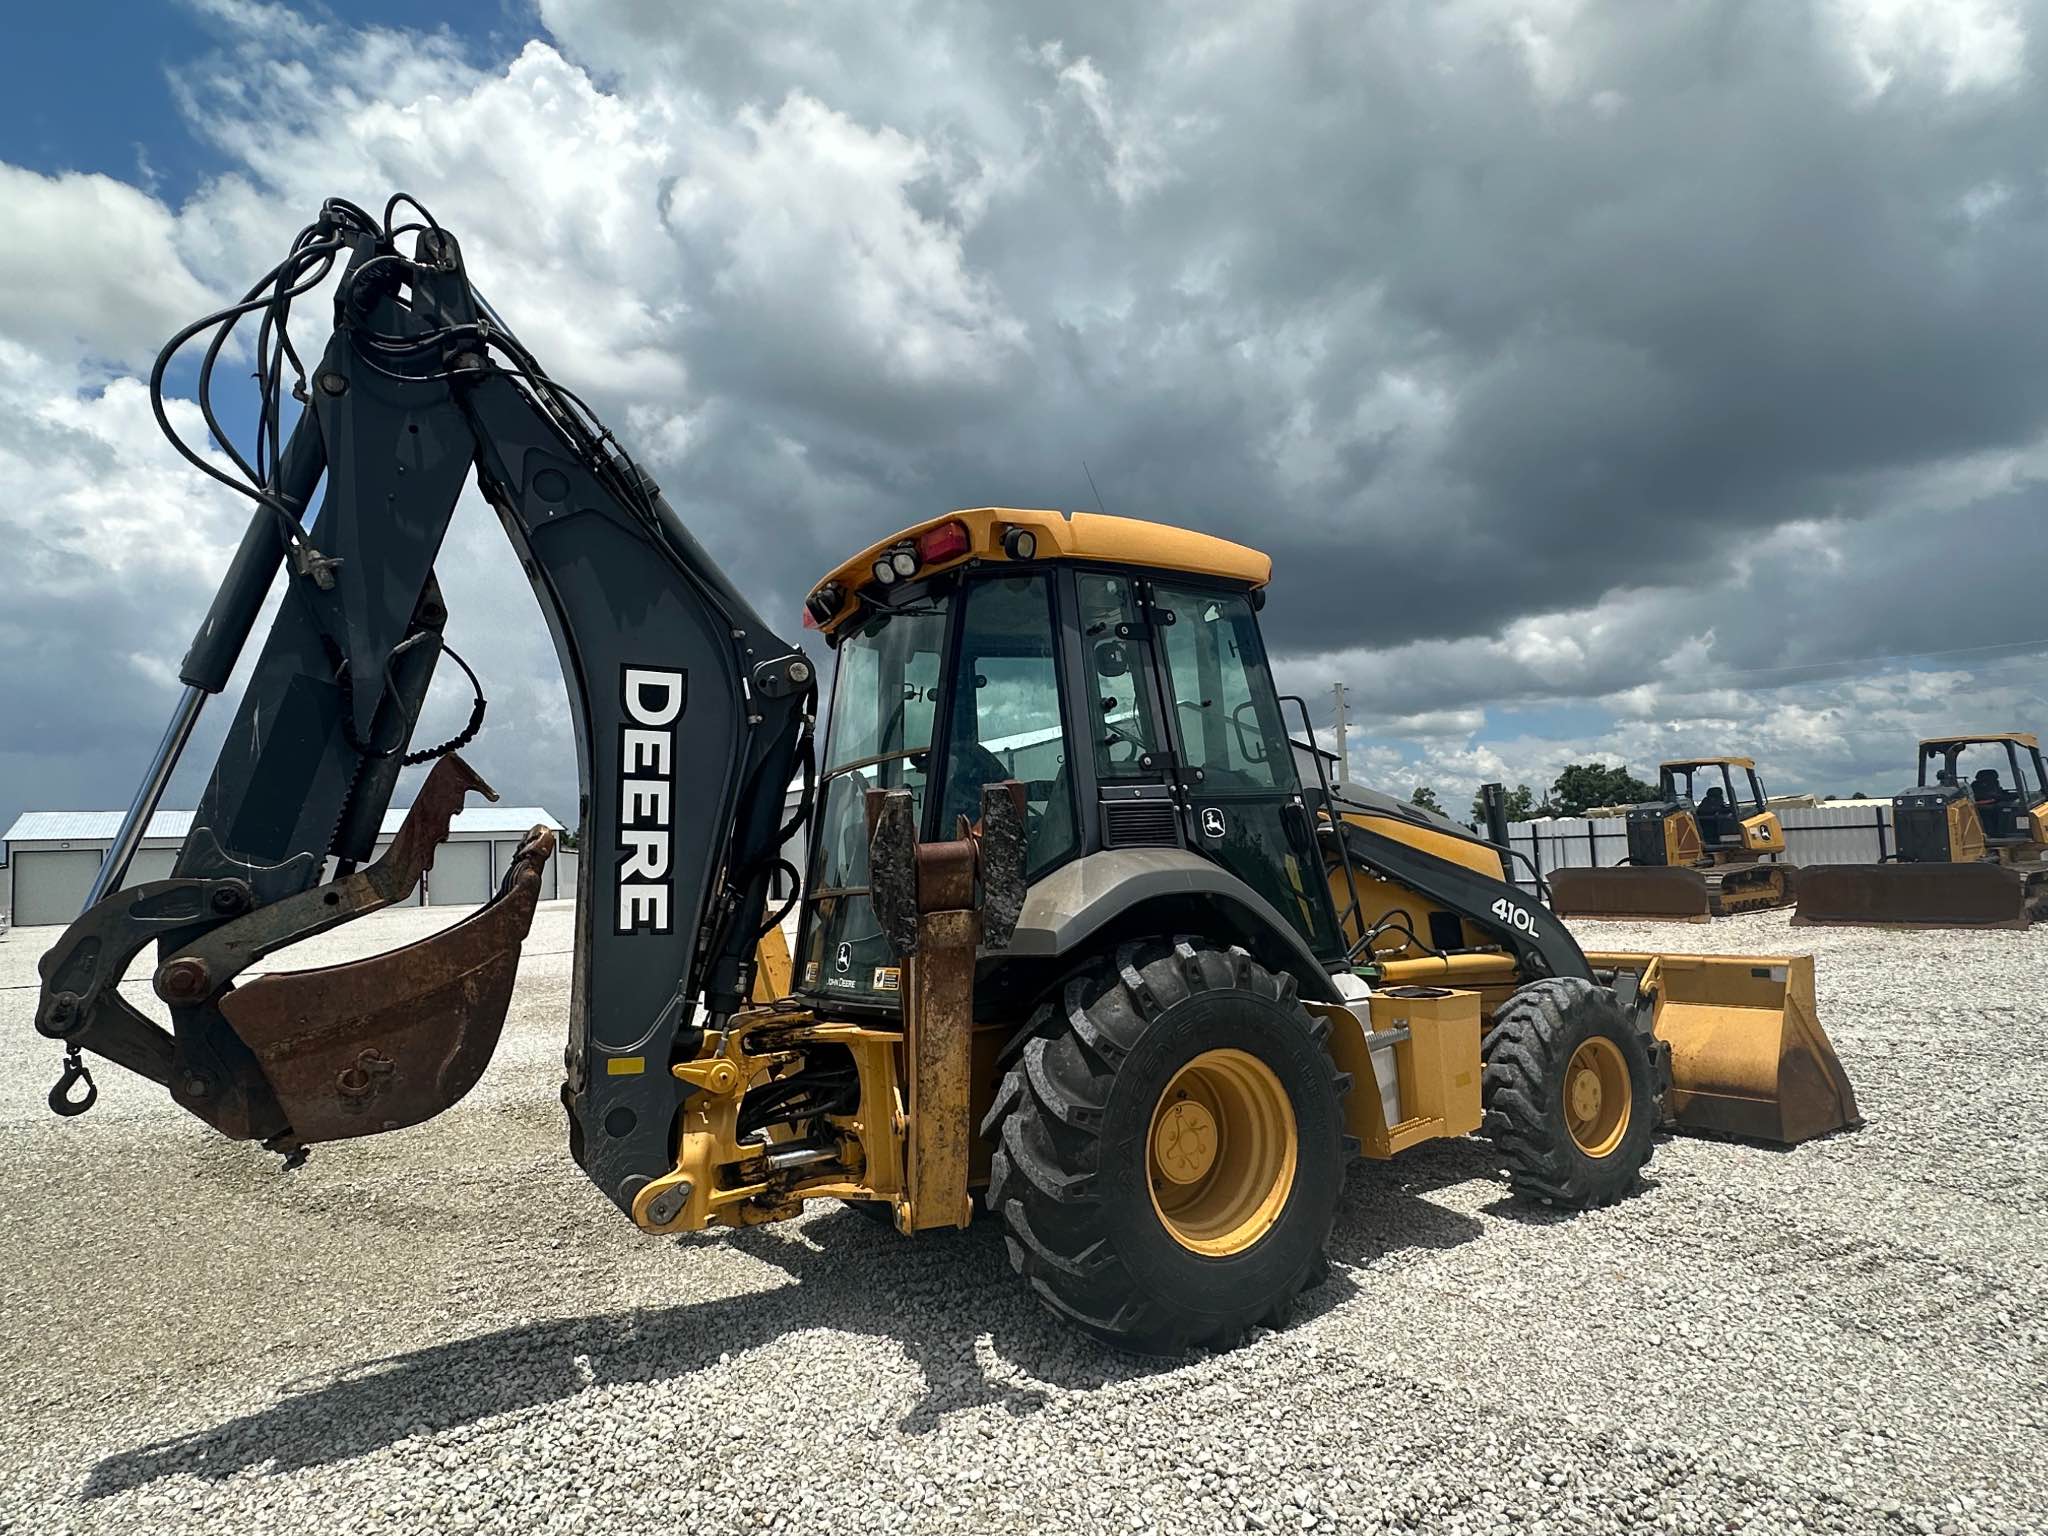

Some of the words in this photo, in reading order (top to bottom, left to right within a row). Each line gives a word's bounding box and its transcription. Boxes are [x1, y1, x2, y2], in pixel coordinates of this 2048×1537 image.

[620, 669, 682, 930] DEERE
[1491, 898, 1540, 938] 410L
[826, 977, 839, 987] JOHN
[839, 978, 856, 989] DEERE
